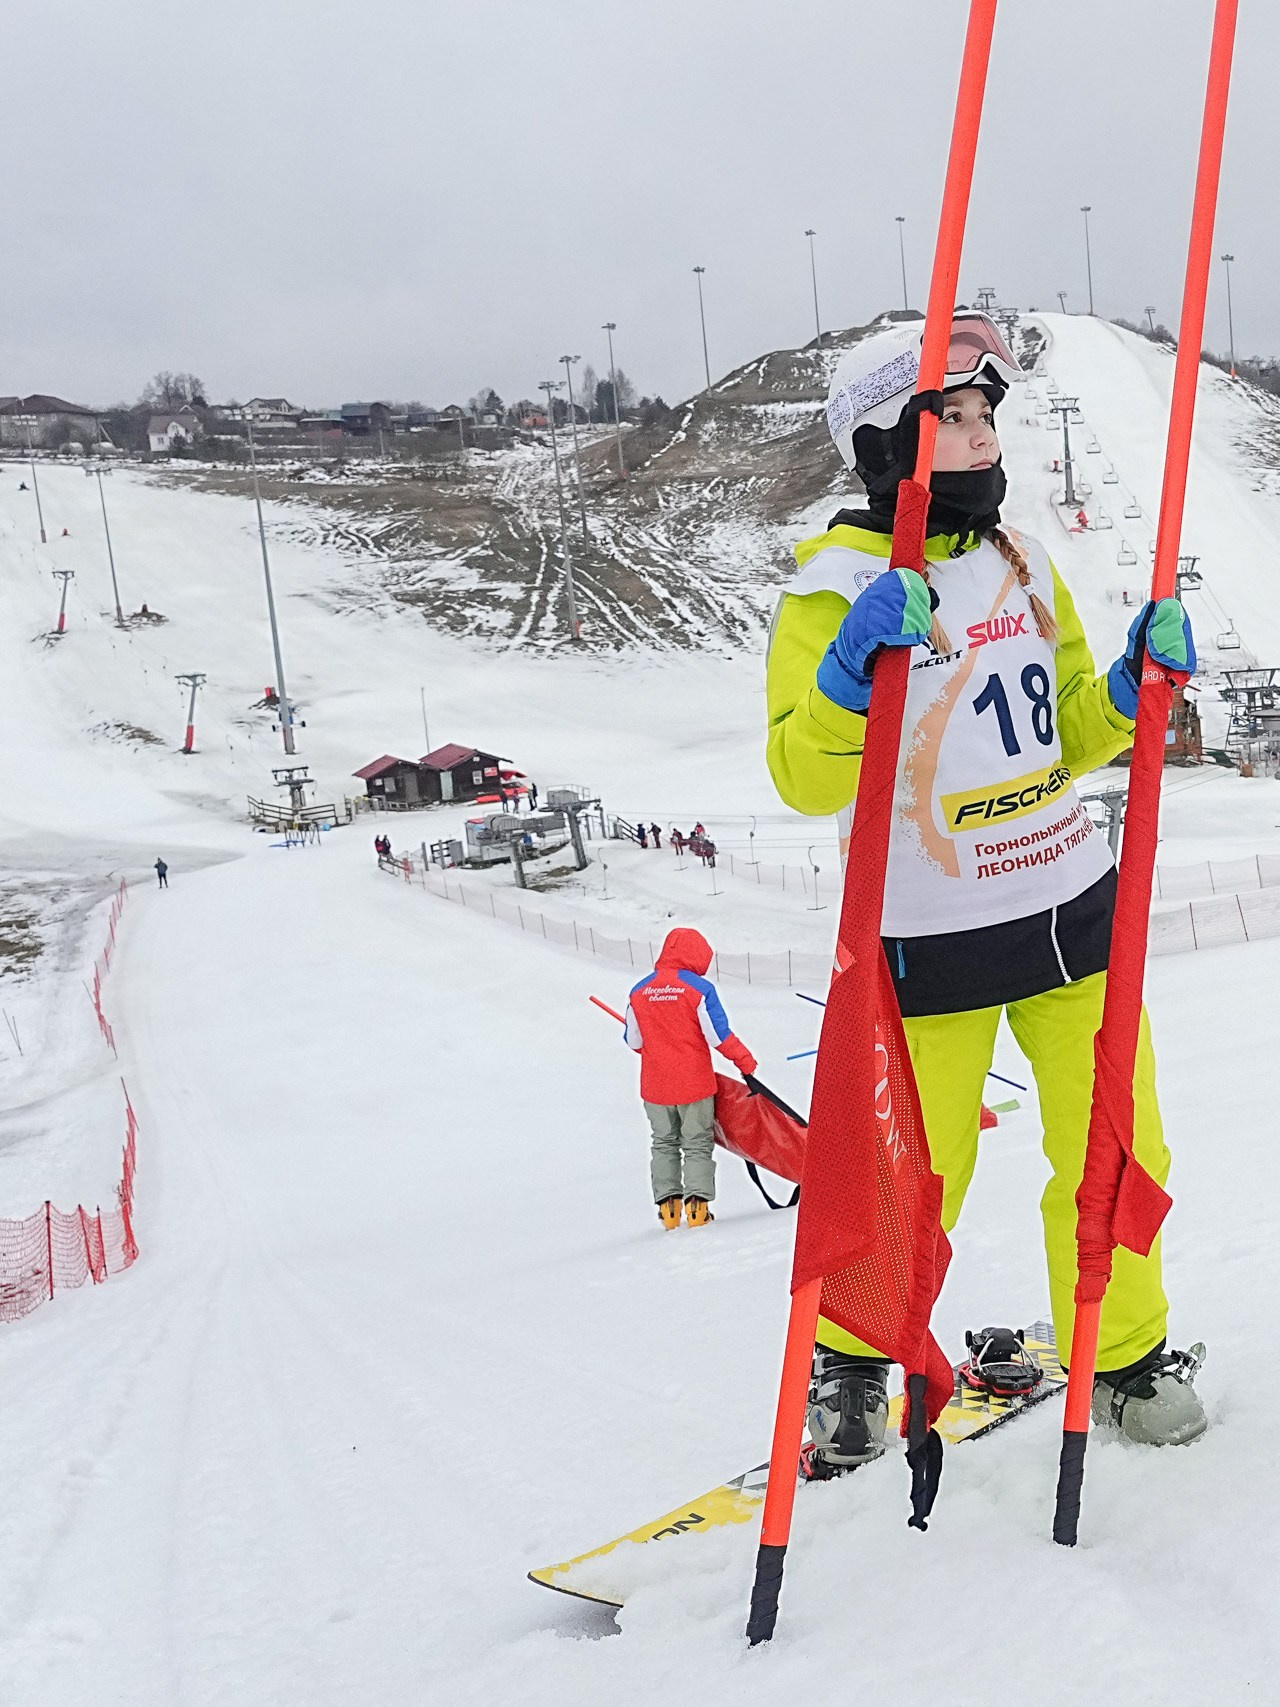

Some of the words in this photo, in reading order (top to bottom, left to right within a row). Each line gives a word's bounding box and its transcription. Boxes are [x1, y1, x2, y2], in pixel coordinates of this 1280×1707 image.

[910, 649, 963, 671] SCOTT
[972, 663, 1054, 757] 18
[954, 767, 1071, 825] FISCHER
[976, 842, 1065, 880] ЛЕОНИДА
